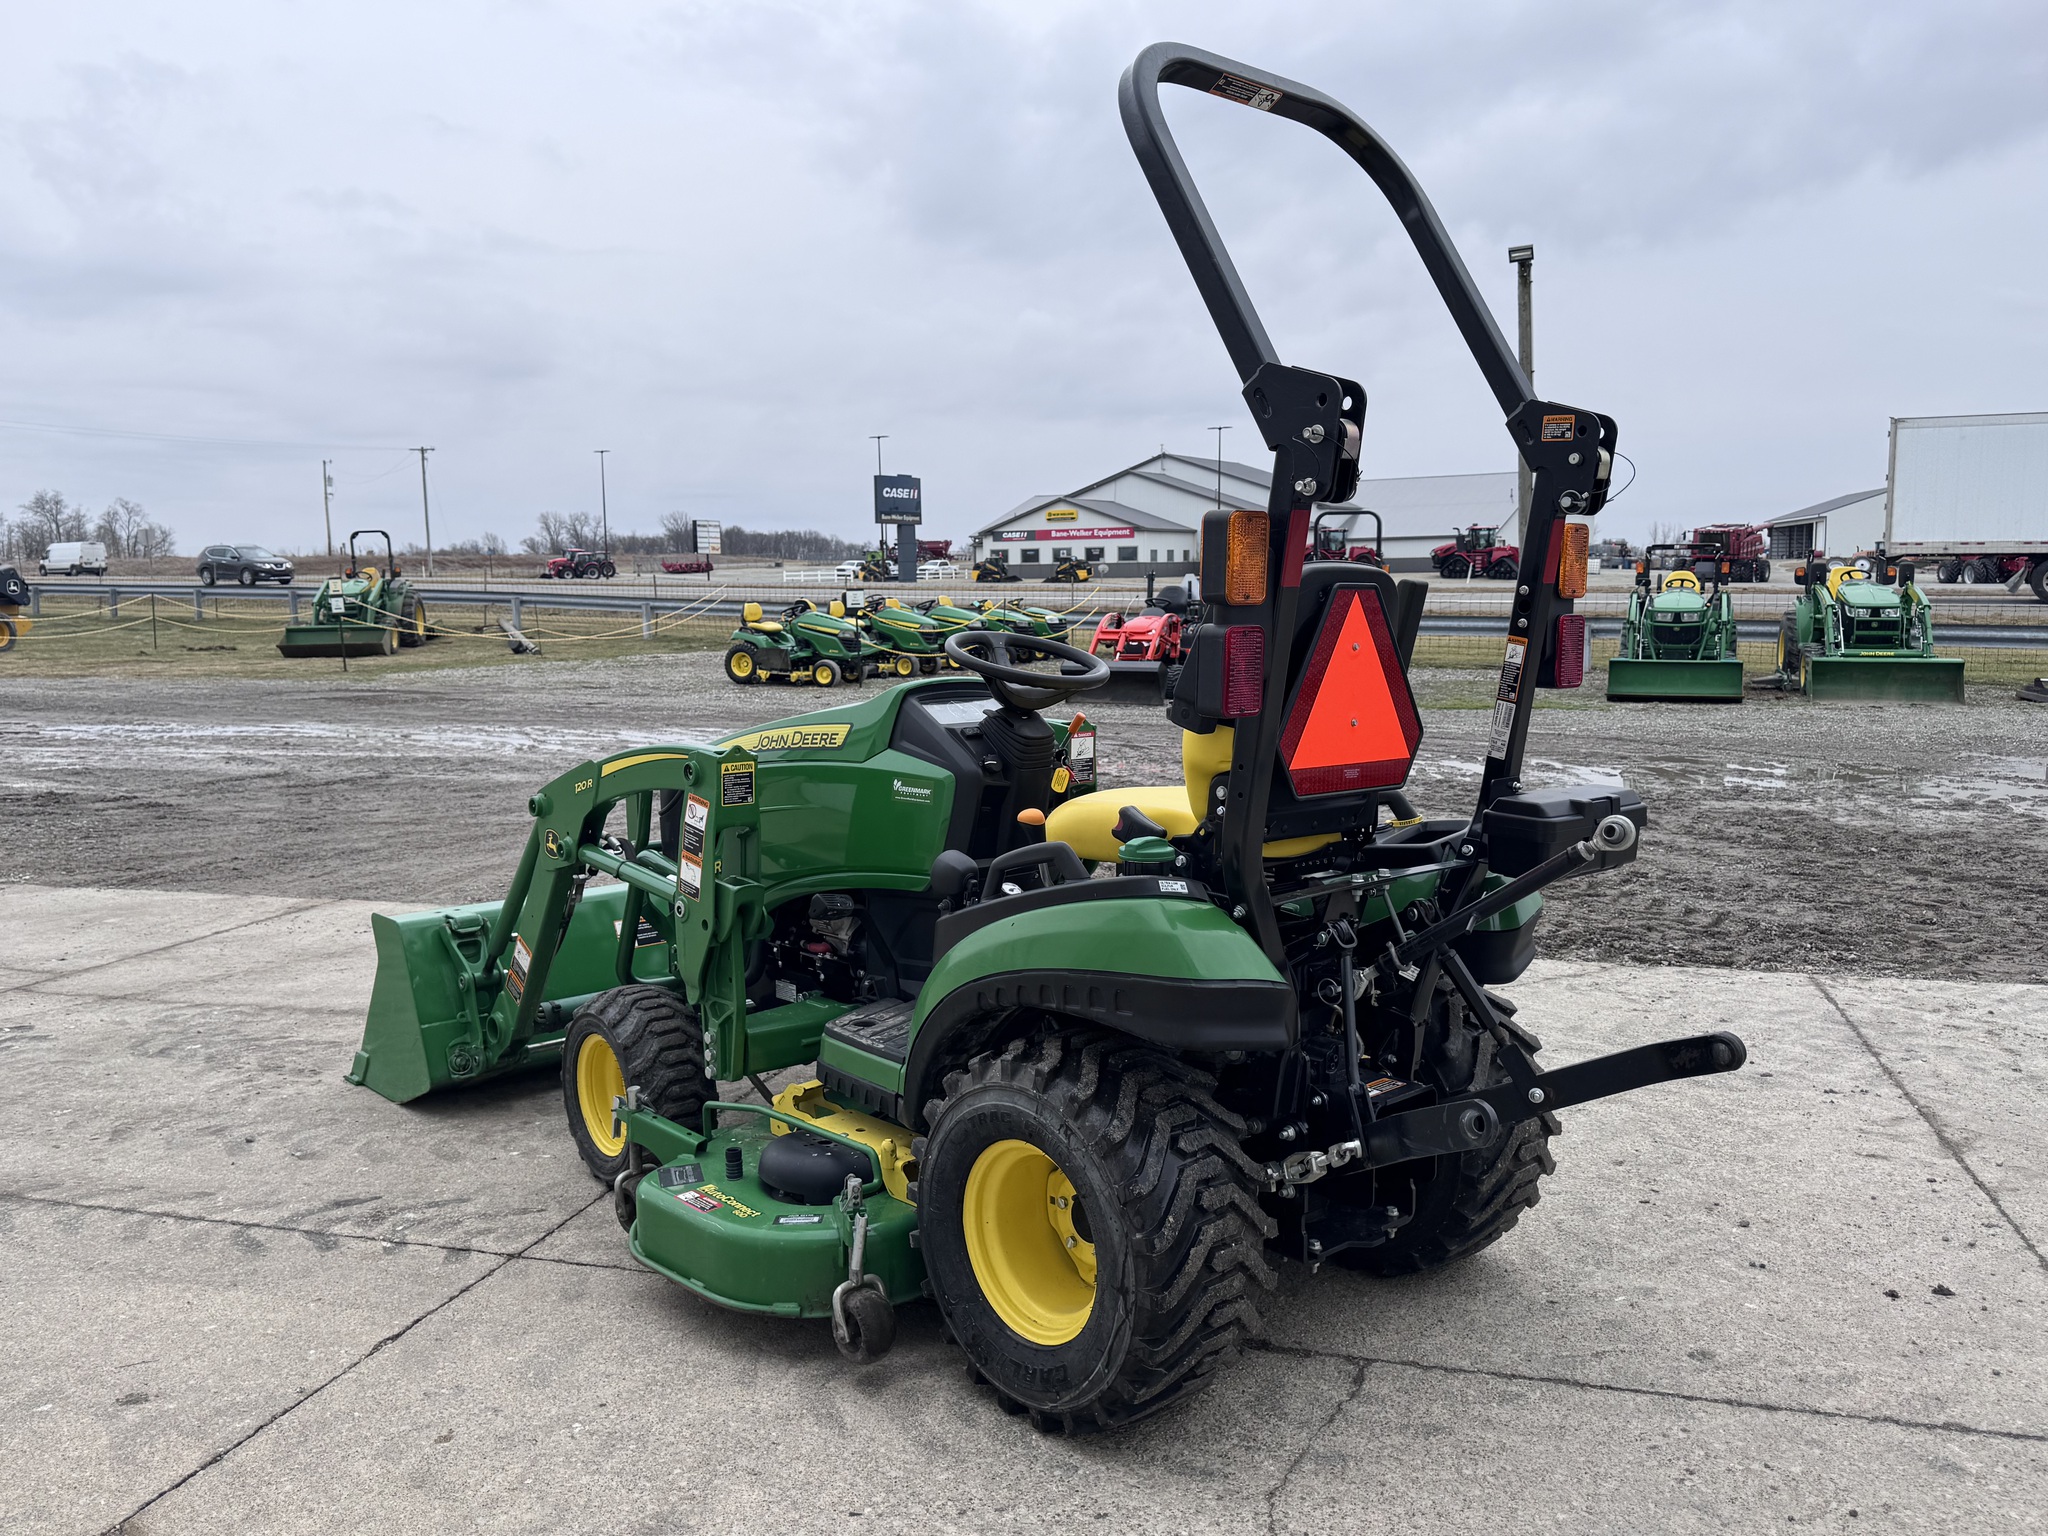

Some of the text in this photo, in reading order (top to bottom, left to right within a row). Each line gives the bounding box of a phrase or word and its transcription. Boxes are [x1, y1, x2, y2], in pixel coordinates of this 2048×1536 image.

[1051, 528, 1130, 538] Bane-Welker Equipment
[753, 731, 839, 749] JOHN DEERE
[730, 763, 753, 772] CAUTION
[898, 786, 932, 795] GREENMARK
[697, 1184, 762, 1217] AutoConnect
